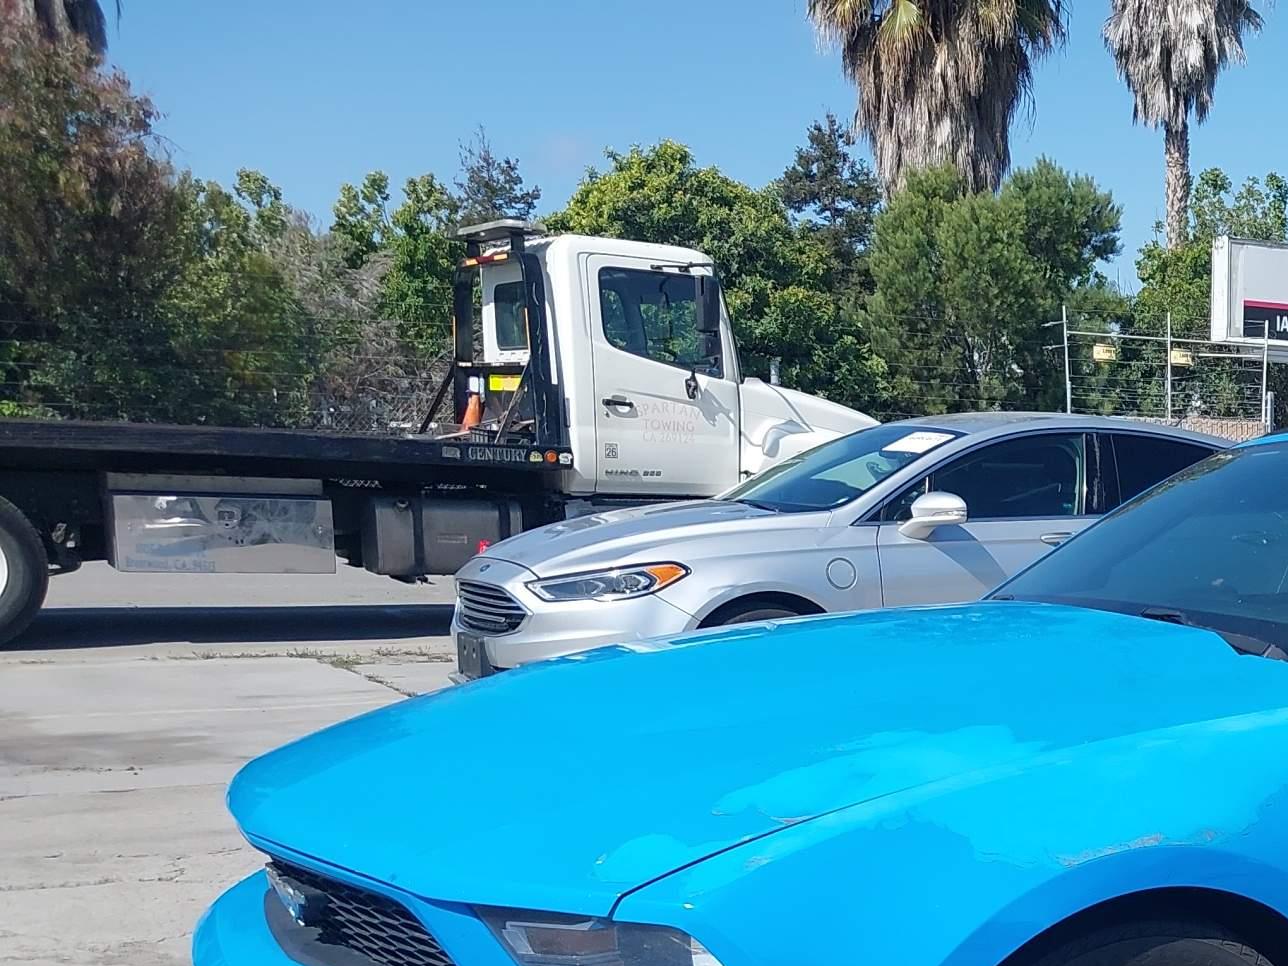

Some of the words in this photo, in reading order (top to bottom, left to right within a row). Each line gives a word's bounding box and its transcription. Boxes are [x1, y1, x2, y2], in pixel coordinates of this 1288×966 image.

[637, 401, 701, 421] SPARTAN
[641, 418, 696, 433] TOWING
[468, 446, 527, 462] CENTURY
[606, 447, 617, 457] 26
